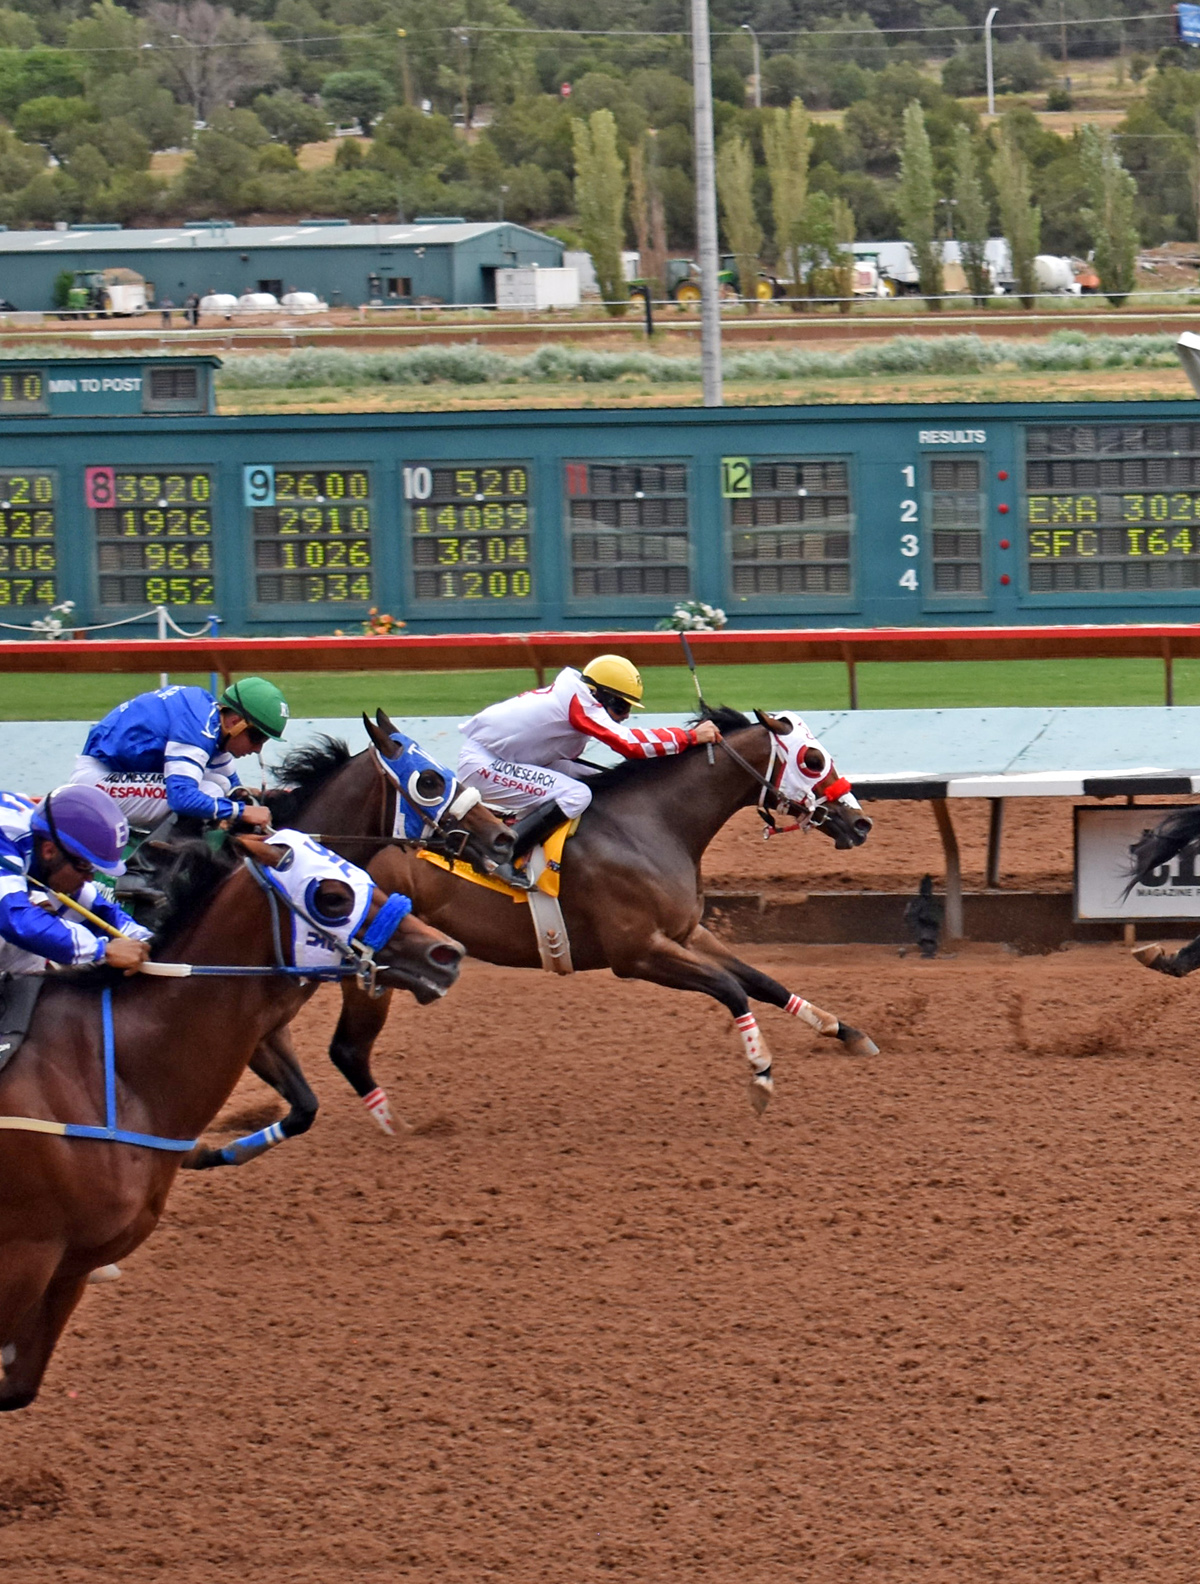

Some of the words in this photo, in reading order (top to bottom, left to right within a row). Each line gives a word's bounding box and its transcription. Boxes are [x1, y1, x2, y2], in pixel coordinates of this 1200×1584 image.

[1, 375, 41, 400] 10
[49, 379, 77, 392] MIN
[80, 379, 101, 391] TO
[102, 378, 142, 391] POST
[919, 430, 986, 443] RESULTS
[91, 471, 111, 503] 8
[117, 475, 210, 502] 3920
[251, 470, 270, 501] 9
[276, 473, 369, 500] 2600
[403, 467, 432, 499] 10
[456, 469, 526, 497] 520
[566, 464, 588, 494] 11
[723, 461, 750, 493] 12
[901, 465, 915, 487] 1
[123, 510, 211, 536] 1926
[278, 507, 369, 534] 2910
[416, 504, 528, 533] 14089
[900, 500, 918, 522] 2
[1029, 496, 1098, 523] EXA
[145, 543, 212, 569] 964
[282, 541, 370, 569] 1026
[438, 537, 528, 565] 3604
[901, 534, 919, 557] 3
[1030, 530, 1098, 557] SFC
[146, 578, 214, 604] 852
[440, 570, 530, 598] 1200
[899, 569, 919, 591] 4
[1136, 888, 1193, 897] MAGAZINE
